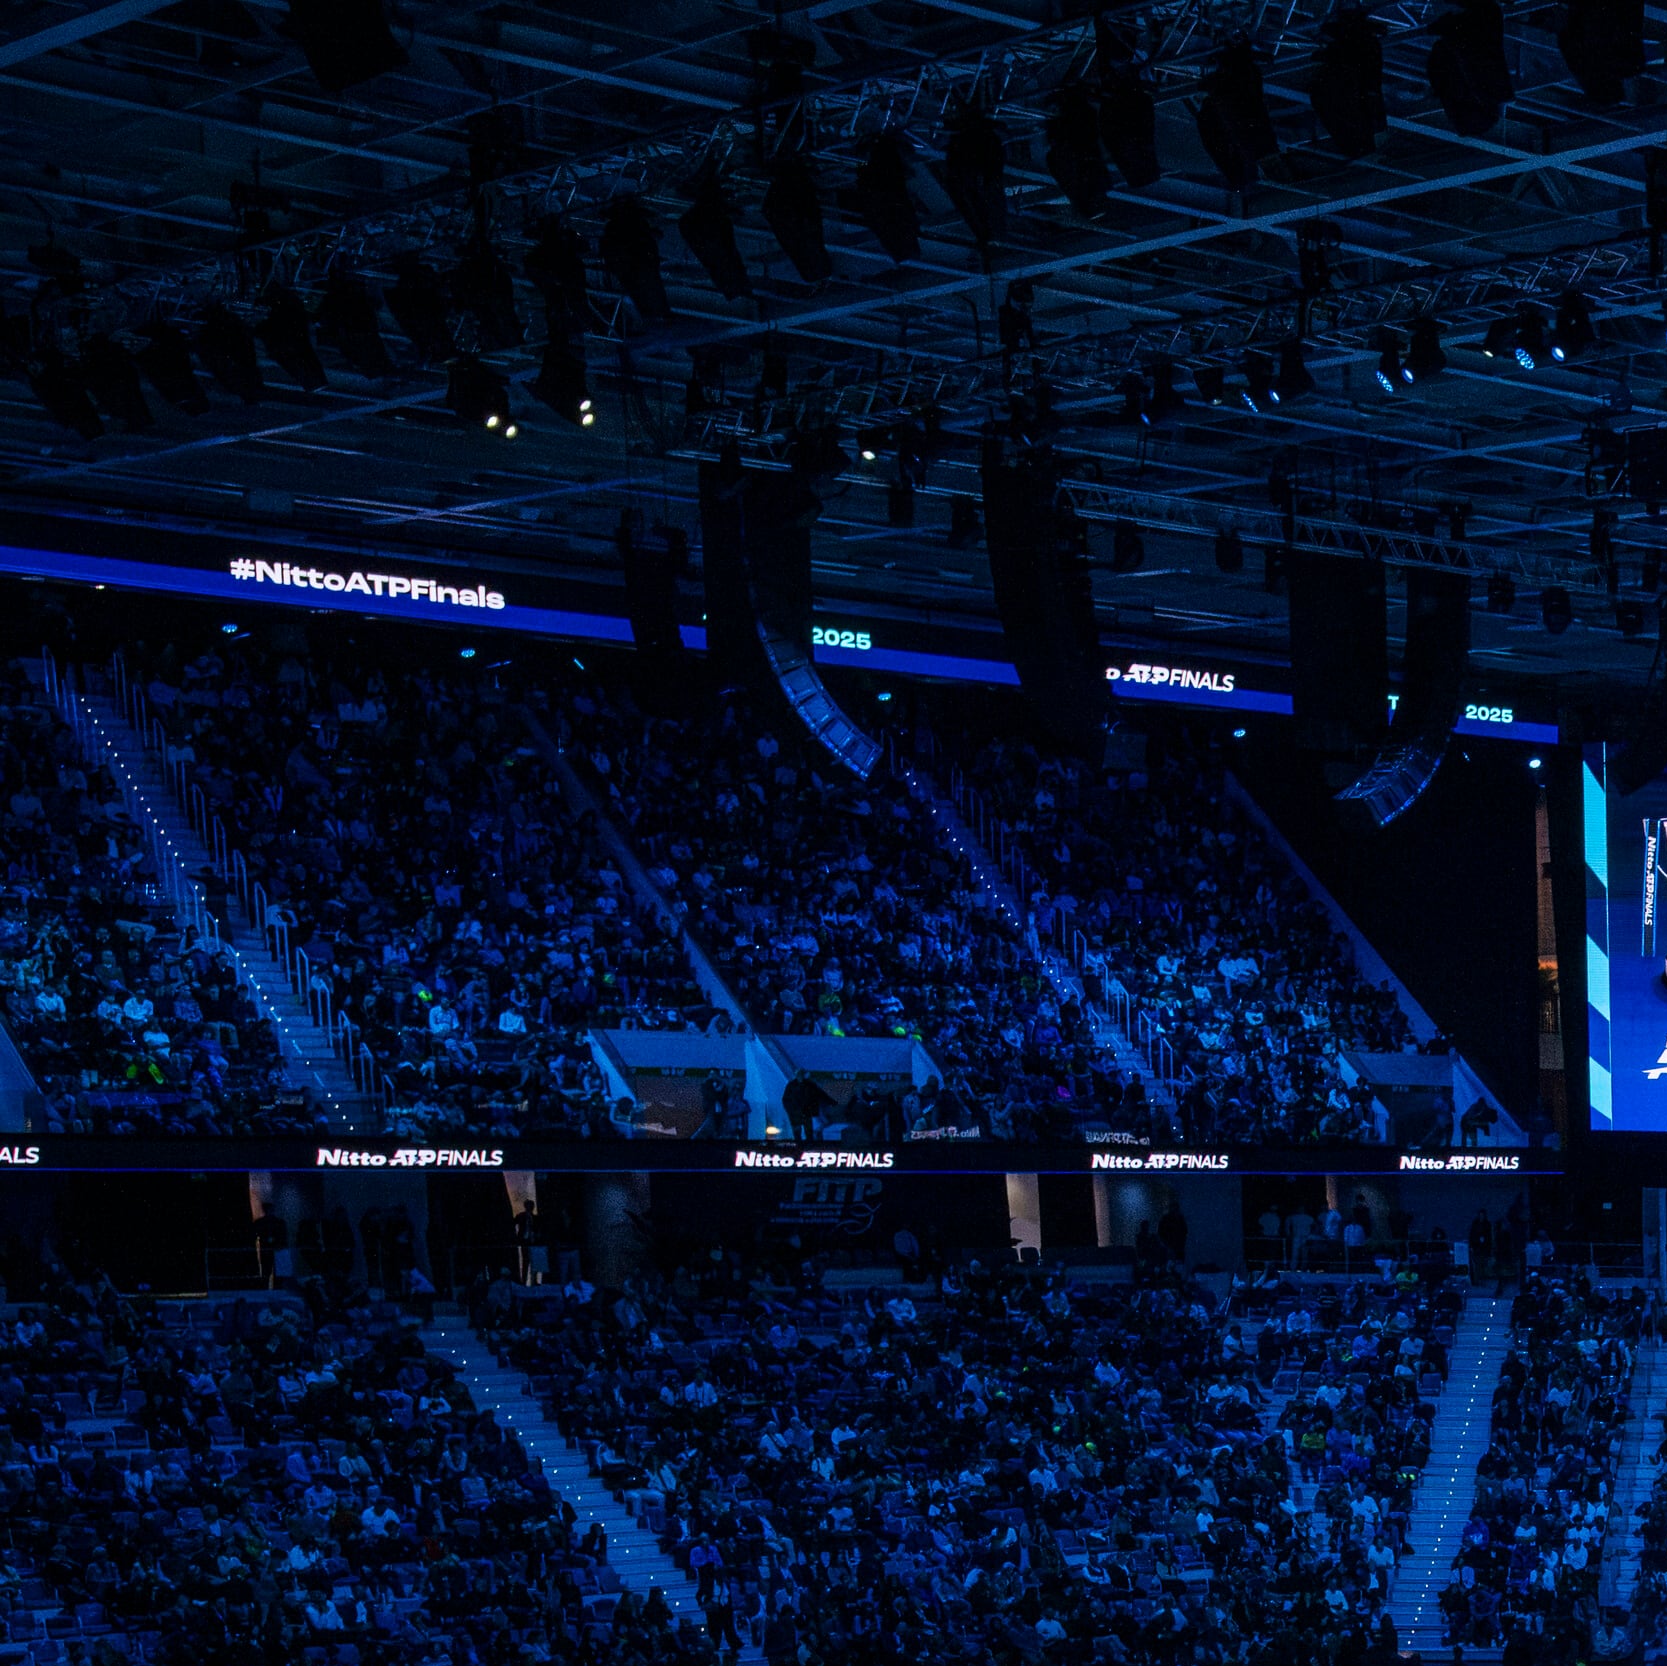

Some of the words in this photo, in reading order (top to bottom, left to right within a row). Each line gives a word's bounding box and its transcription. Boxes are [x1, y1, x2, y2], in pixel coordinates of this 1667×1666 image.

[230, 558, 506, 610] #NittoATPFinals
[812, 627, 872, 650] 2025
[1465, 705, 1513, 723] 2025
[317, 1148, 386, 1166] Nitto
[436, 1149, 503, 1166] FINALS
[1091, 1153, 1143, 1169] Nitto
[1179, 1154, 1229, 1169] FINALS
